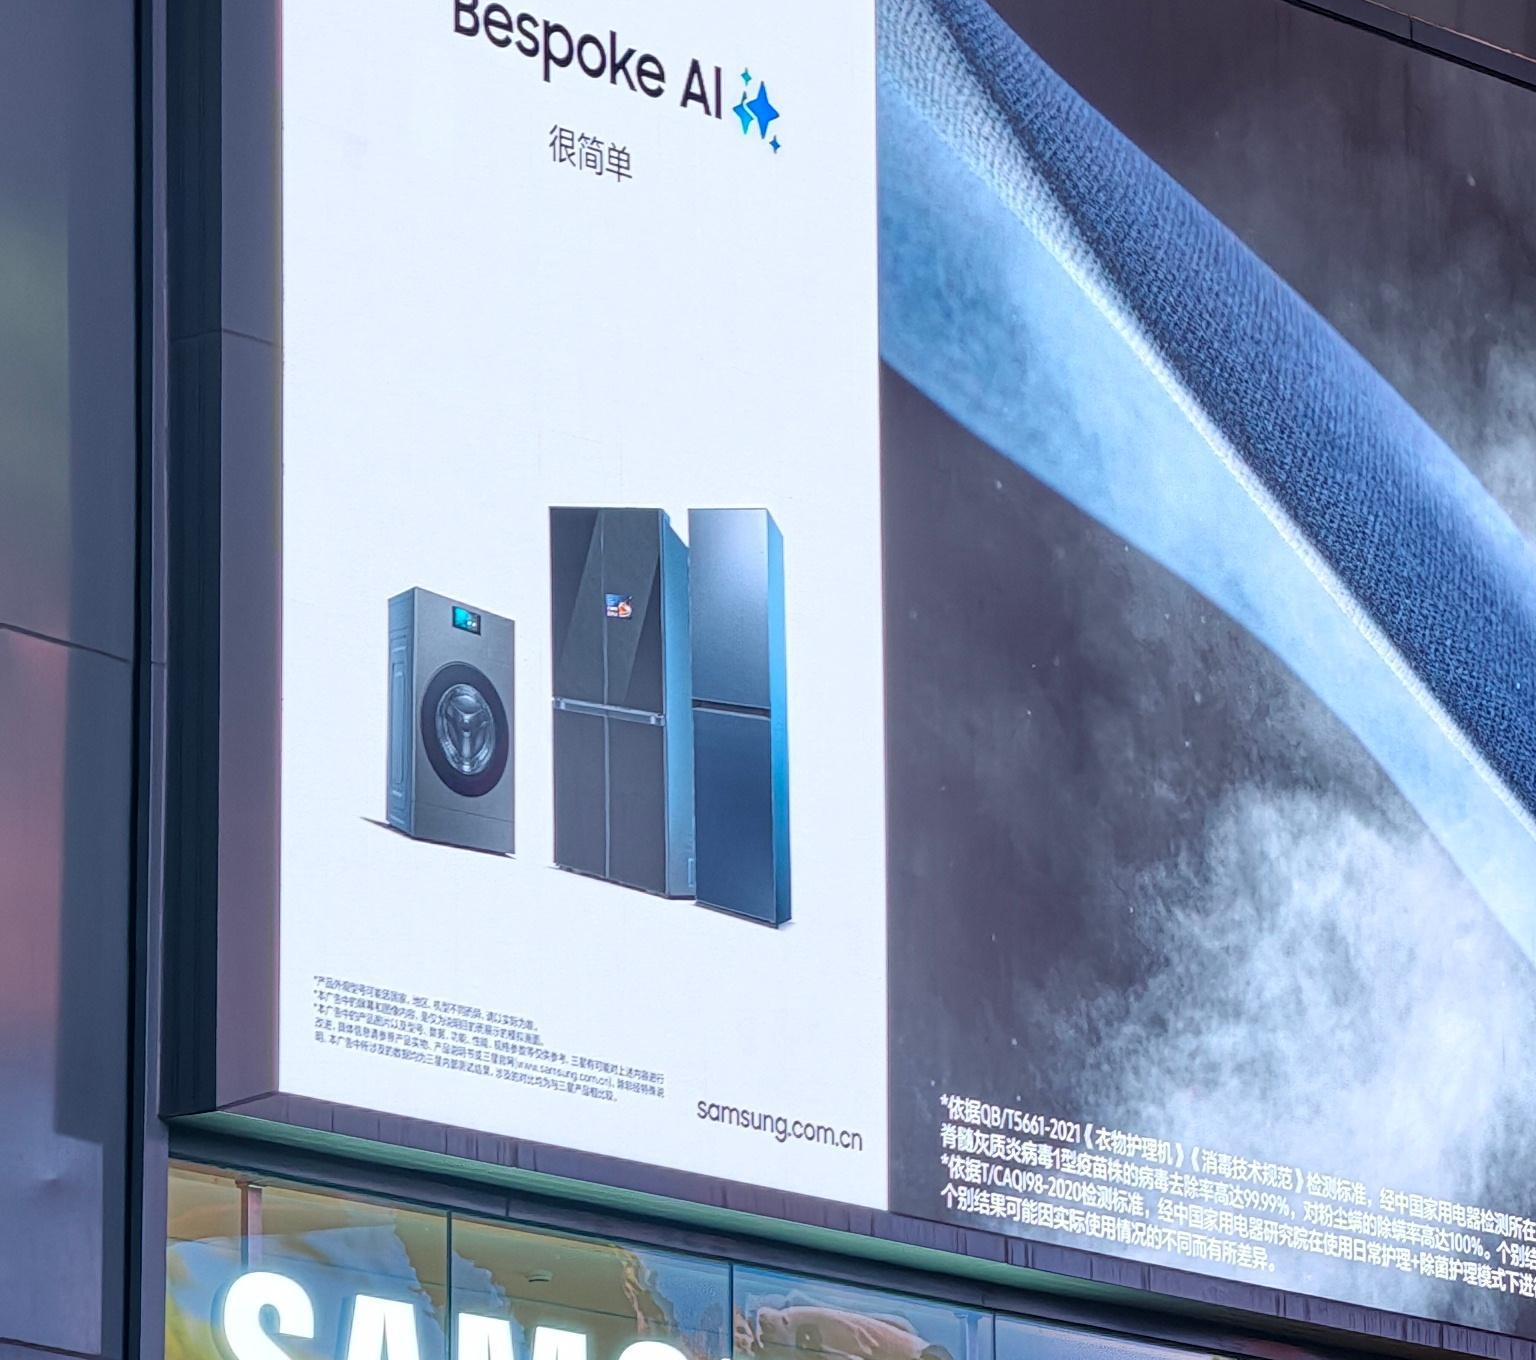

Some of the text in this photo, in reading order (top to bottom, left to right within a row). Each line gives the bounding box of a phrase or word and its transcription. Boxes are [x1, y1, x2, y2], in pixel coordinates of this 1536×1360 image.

[680, 58, 722, 119] AI
[548, 124, 633, 182] 很简单
[696, 1099, 864, 1153] samsung.com.cn
